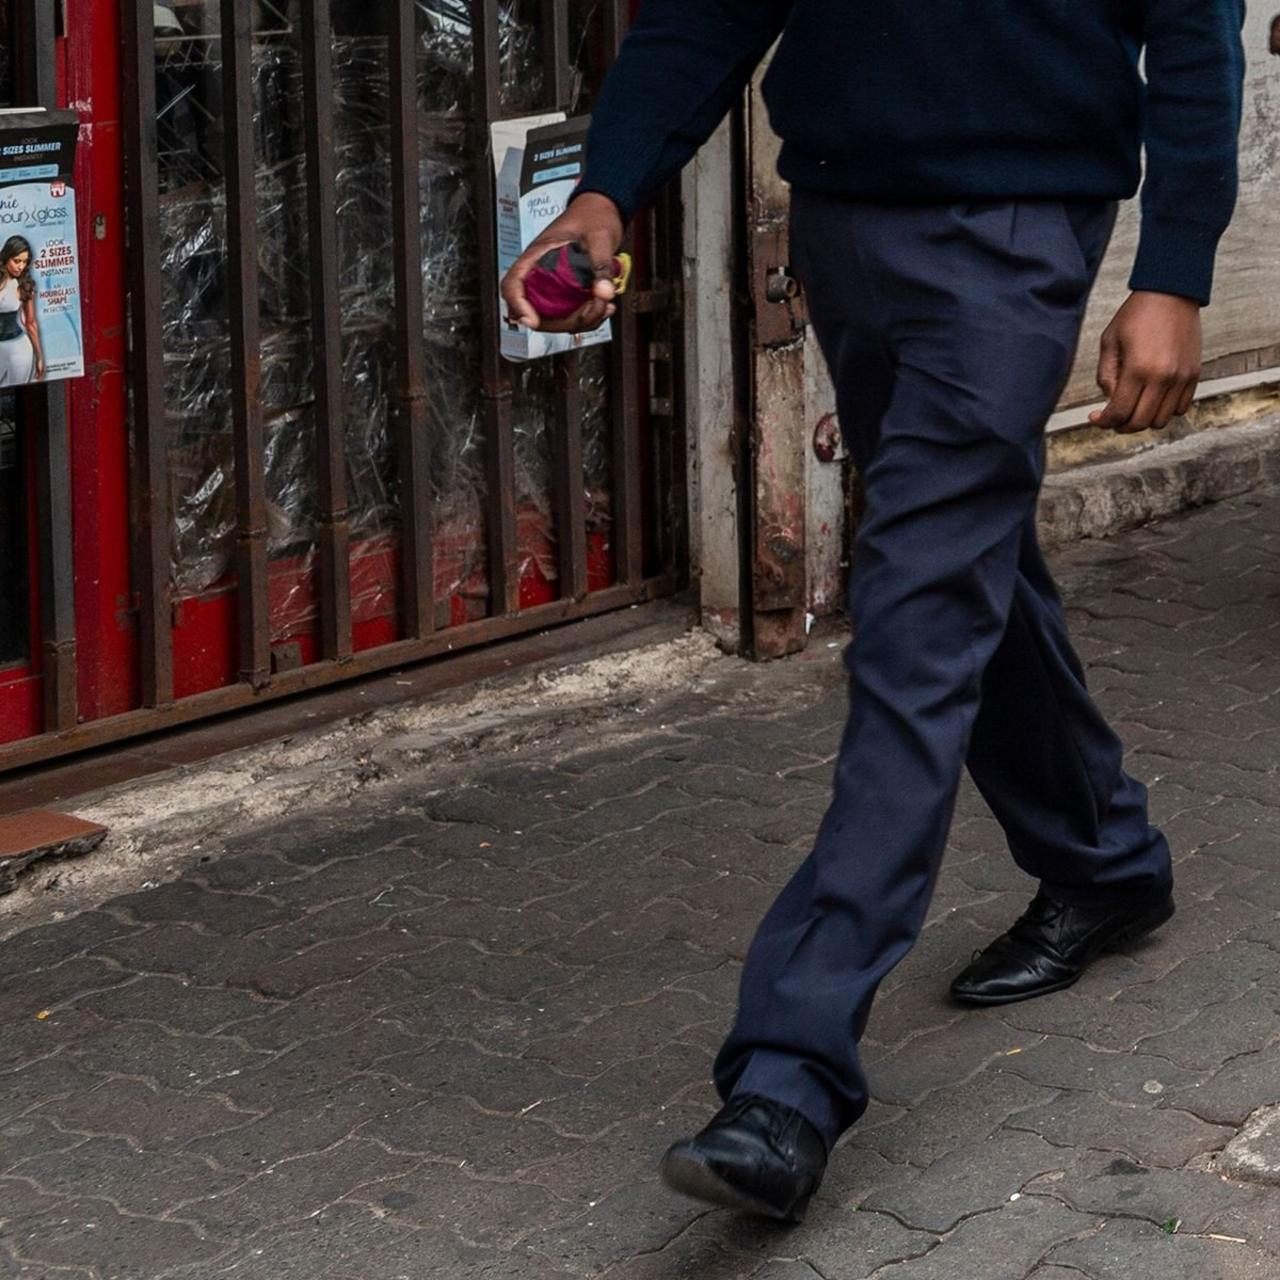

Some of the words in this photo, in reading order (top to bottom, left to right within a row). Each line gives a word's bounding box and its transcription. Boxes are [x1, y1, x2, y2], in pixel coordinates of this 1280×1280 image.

[25, 142, 62, 153] SLIMMER
[49, 247, 72, 257] SIZES
[35, 256, 75, 269] SLIMMER
